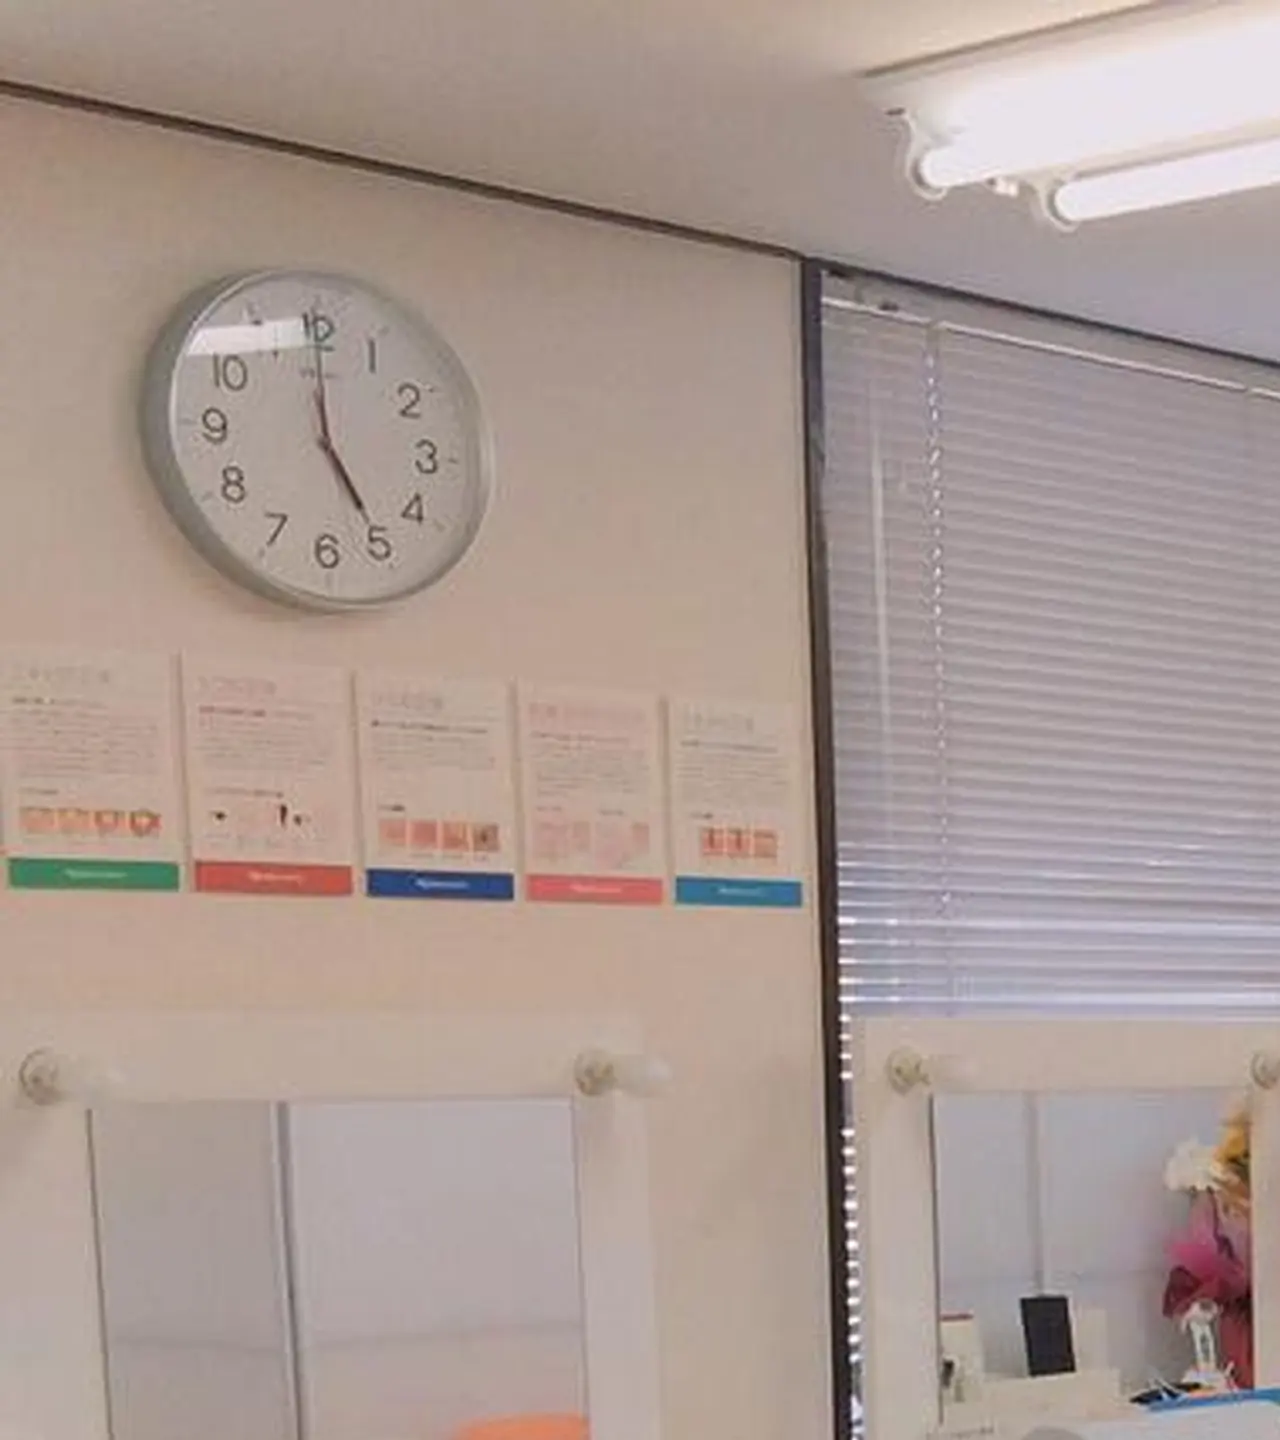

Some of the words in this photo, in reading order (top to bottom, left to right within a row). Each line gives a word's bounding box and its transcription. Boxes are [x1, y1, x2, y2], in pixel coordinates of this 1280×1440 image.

[212, 353, 248, 392] 10
[366, 337, 378, 374] 1
[398, 383, 423, 419] 2
[201, 407, 229, 445] 9
[414, 438, 439, 475] 3
[221, 465, 247, 505] 8
[401, 494, 426, 526] 4
[265, 512, 289, 547] 7
[367, 526, 393, 562] 5
[314, 533, 341, 570] 6
